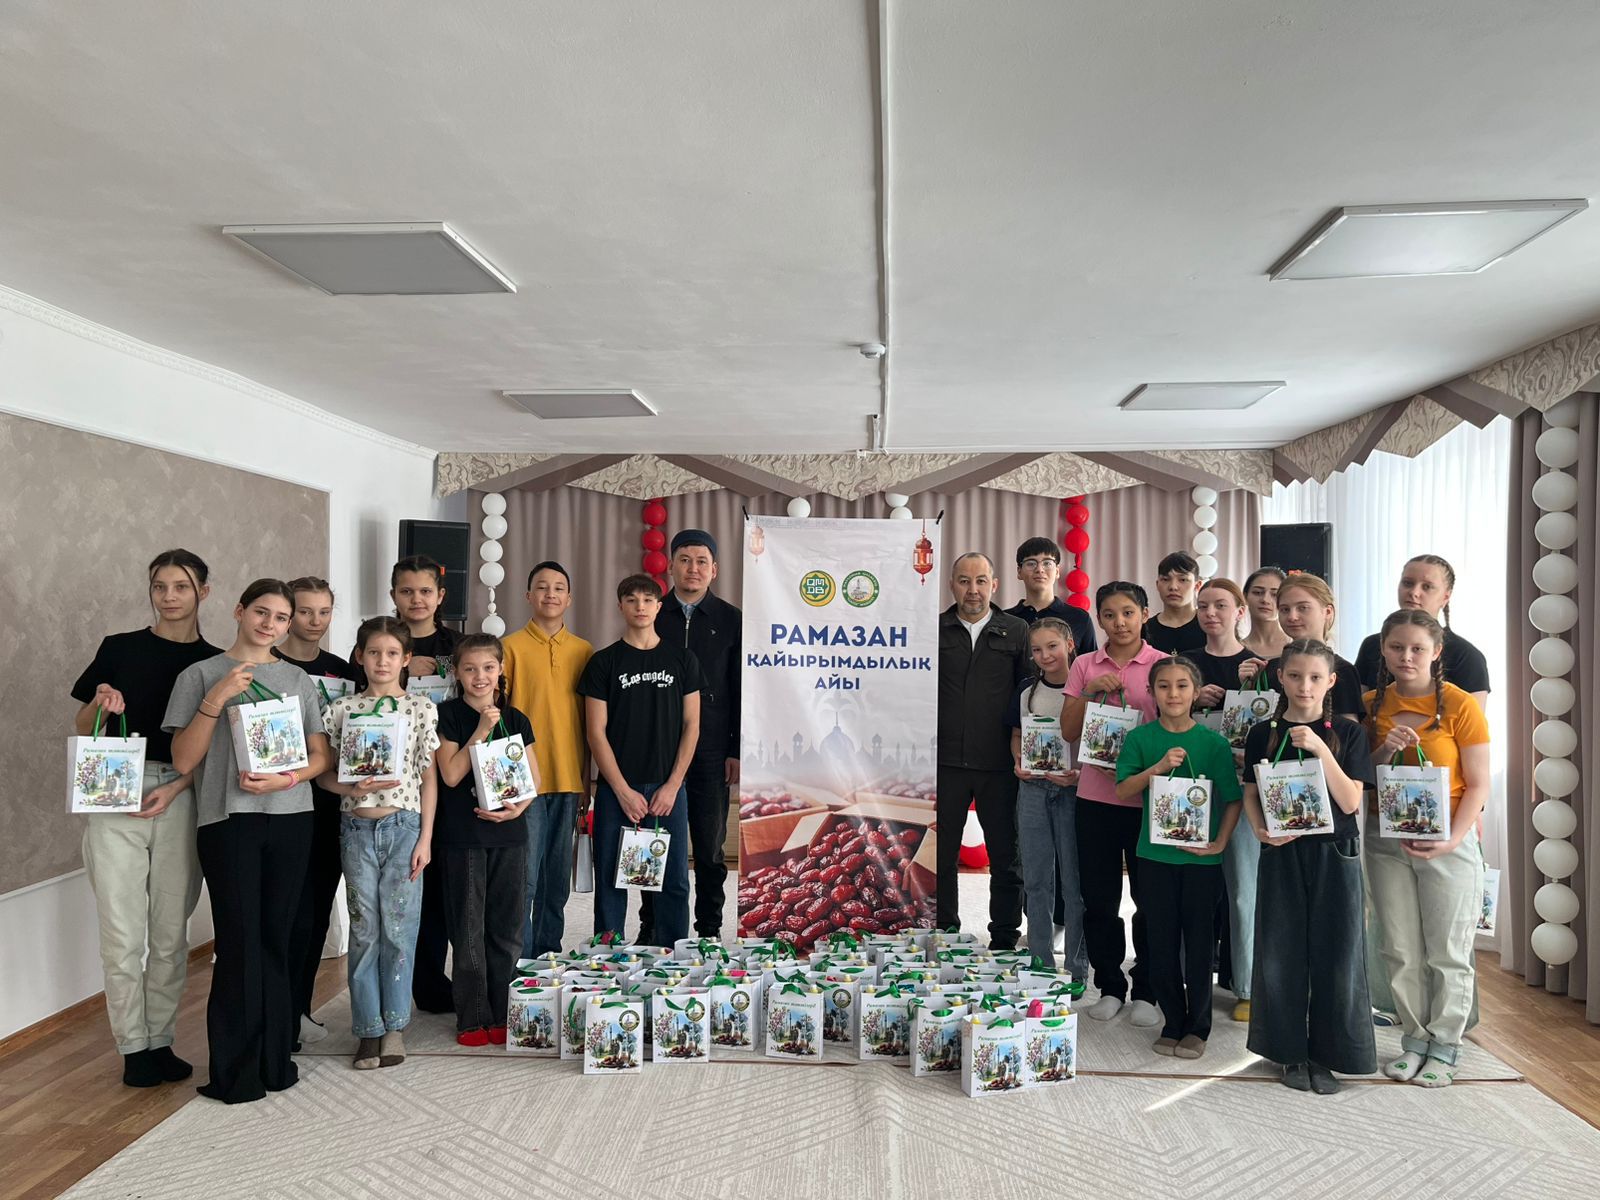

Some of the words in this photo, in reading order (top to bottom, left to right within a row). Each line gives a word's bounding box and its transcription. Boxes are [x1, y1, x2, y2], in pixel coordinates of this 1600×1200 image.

[771, 624, 907, 647] РАМАЗАН
[747, 651, 931, 671] ҚАЙЫРЫМДЫЛЫҚ
[618, 673, 641, 689] Los
[815, 673, 860, 690] АЙЫ
